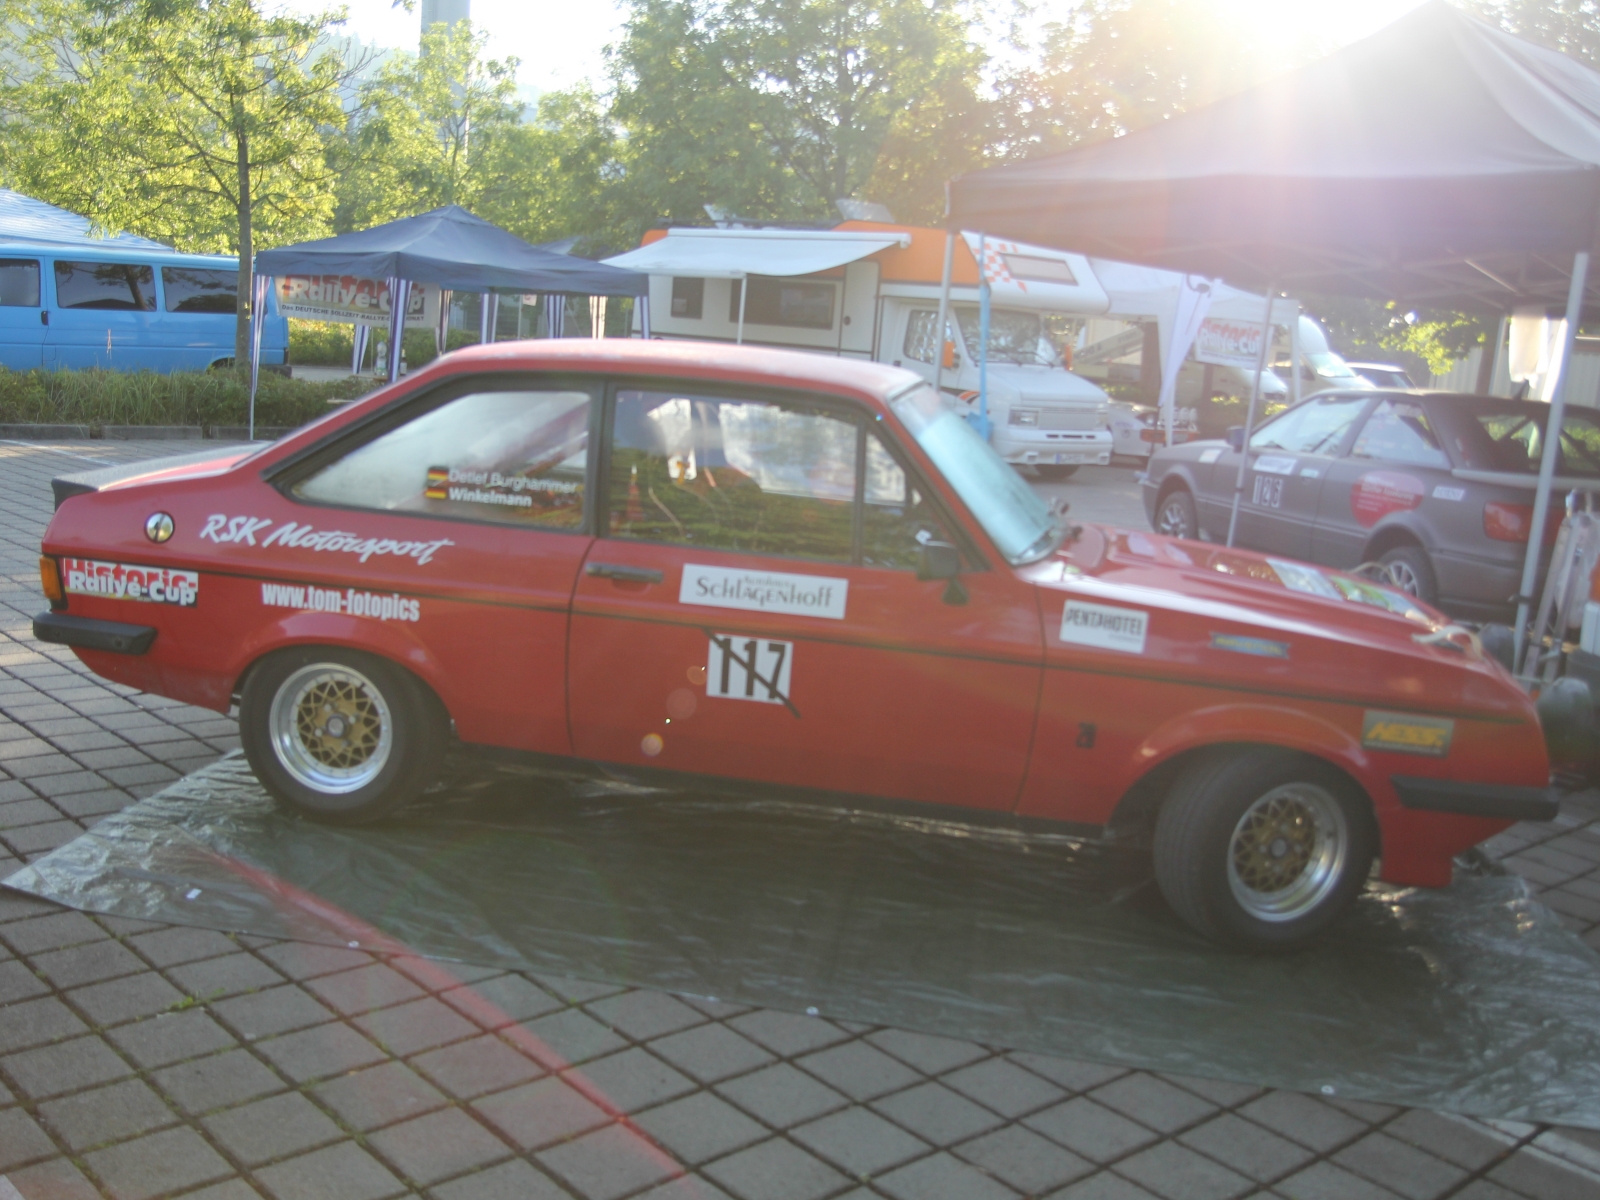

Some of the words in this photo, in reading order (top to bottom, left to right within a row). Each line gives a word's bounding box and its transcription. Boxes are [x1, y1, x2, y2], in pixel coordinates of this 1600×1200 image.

[281, 304, 294, 312] Das
[295, 306, 330, 316] DEUTSCHE
[289, 277, 424, 314] Rallye-Cp
[449, 469, 488, 485] Detlef
[490, 472, 577, 494] Burghammer
[449, 487, 533, 507] Winkelmann
[200, 513, 273, 546] RSK
[262, 521, 455, 566] Motorsport
[69, 570, 196, 606] Rallye-Cup
[262, 583, 420, 622] www.tom-fotopics
[718, 637, 786, 700] 117
